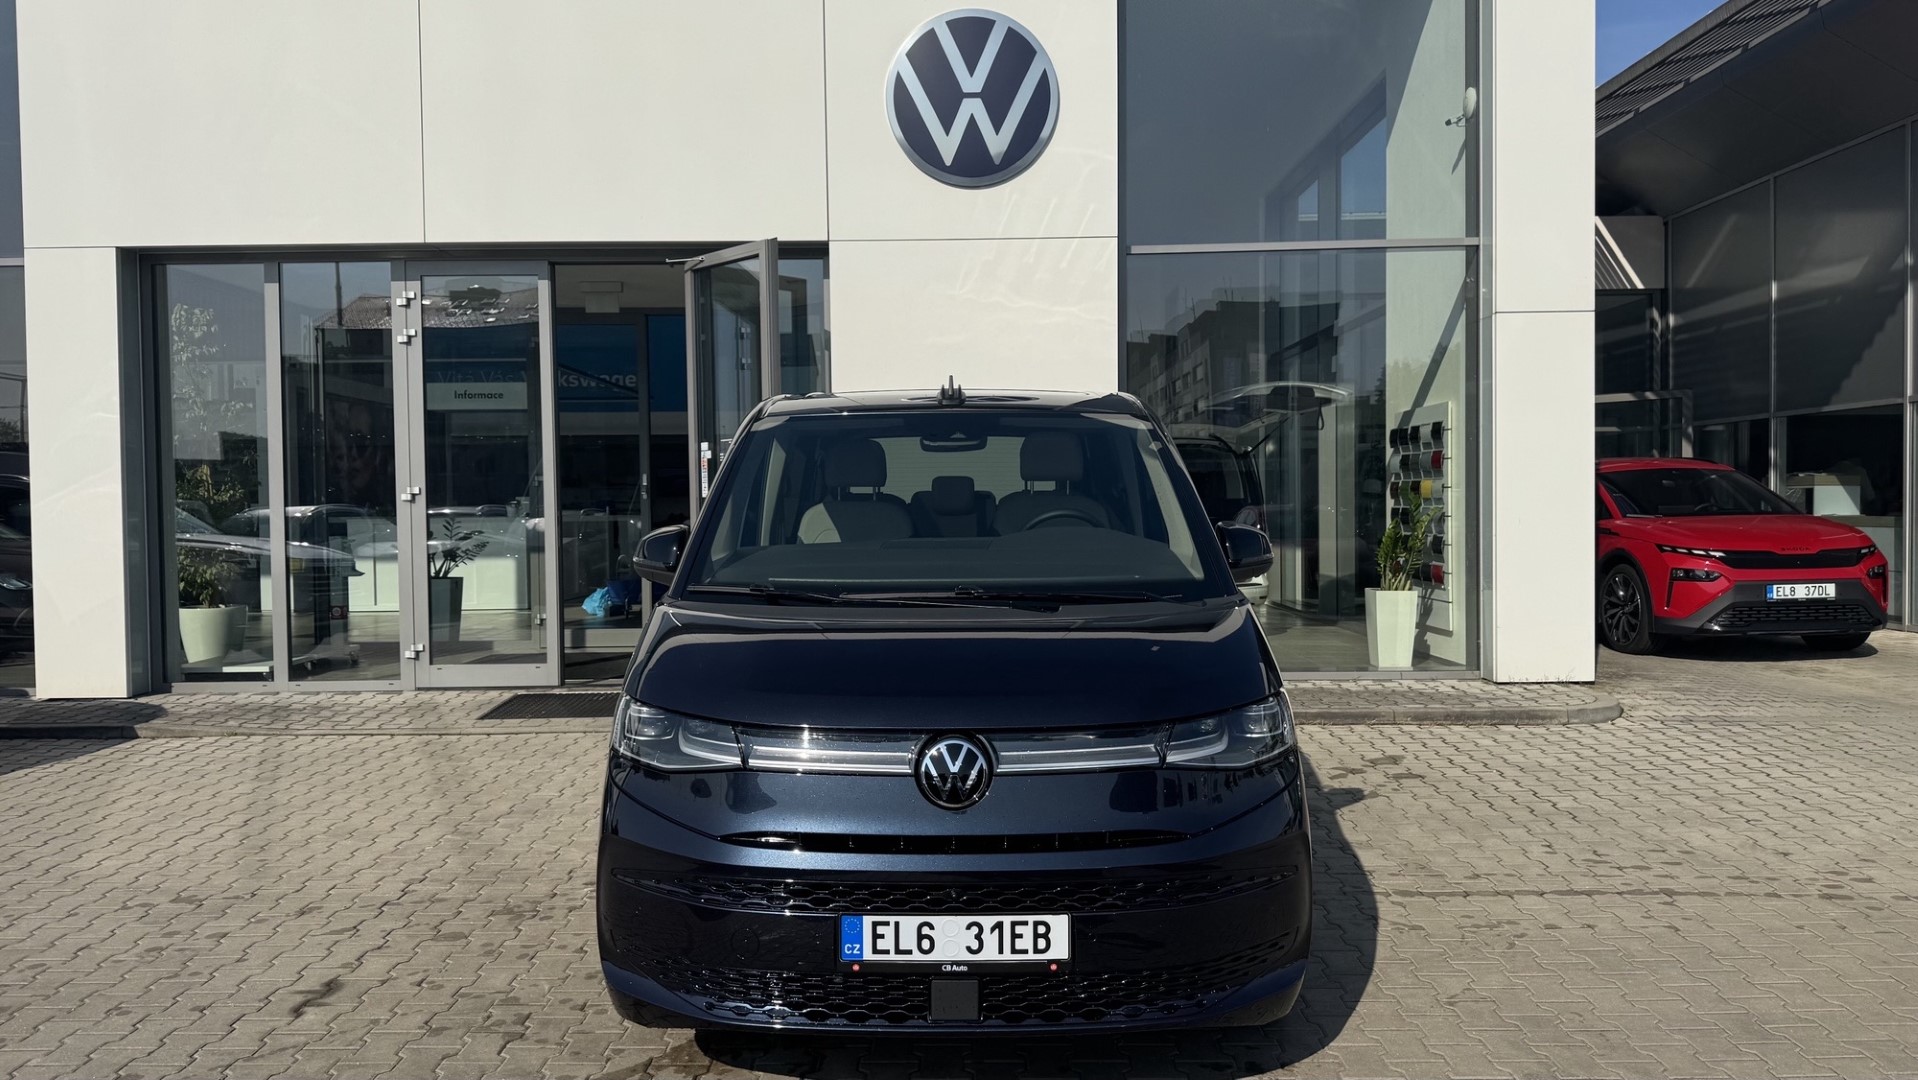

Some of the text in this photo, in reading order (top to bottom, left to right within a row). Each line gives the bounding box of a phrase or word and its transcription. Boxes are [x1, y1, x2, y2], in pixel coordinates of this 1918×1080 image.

[454, 389, 504, 400] Informace
[1776, 586, 1796, 597] EL8
[1804, 585, 1830, 597] 37DL
[871, 920, 1052, 956] EL6 31EB
[844, 944, 861, 955] CZ
[941, 964, 968, 972] CB Auto
